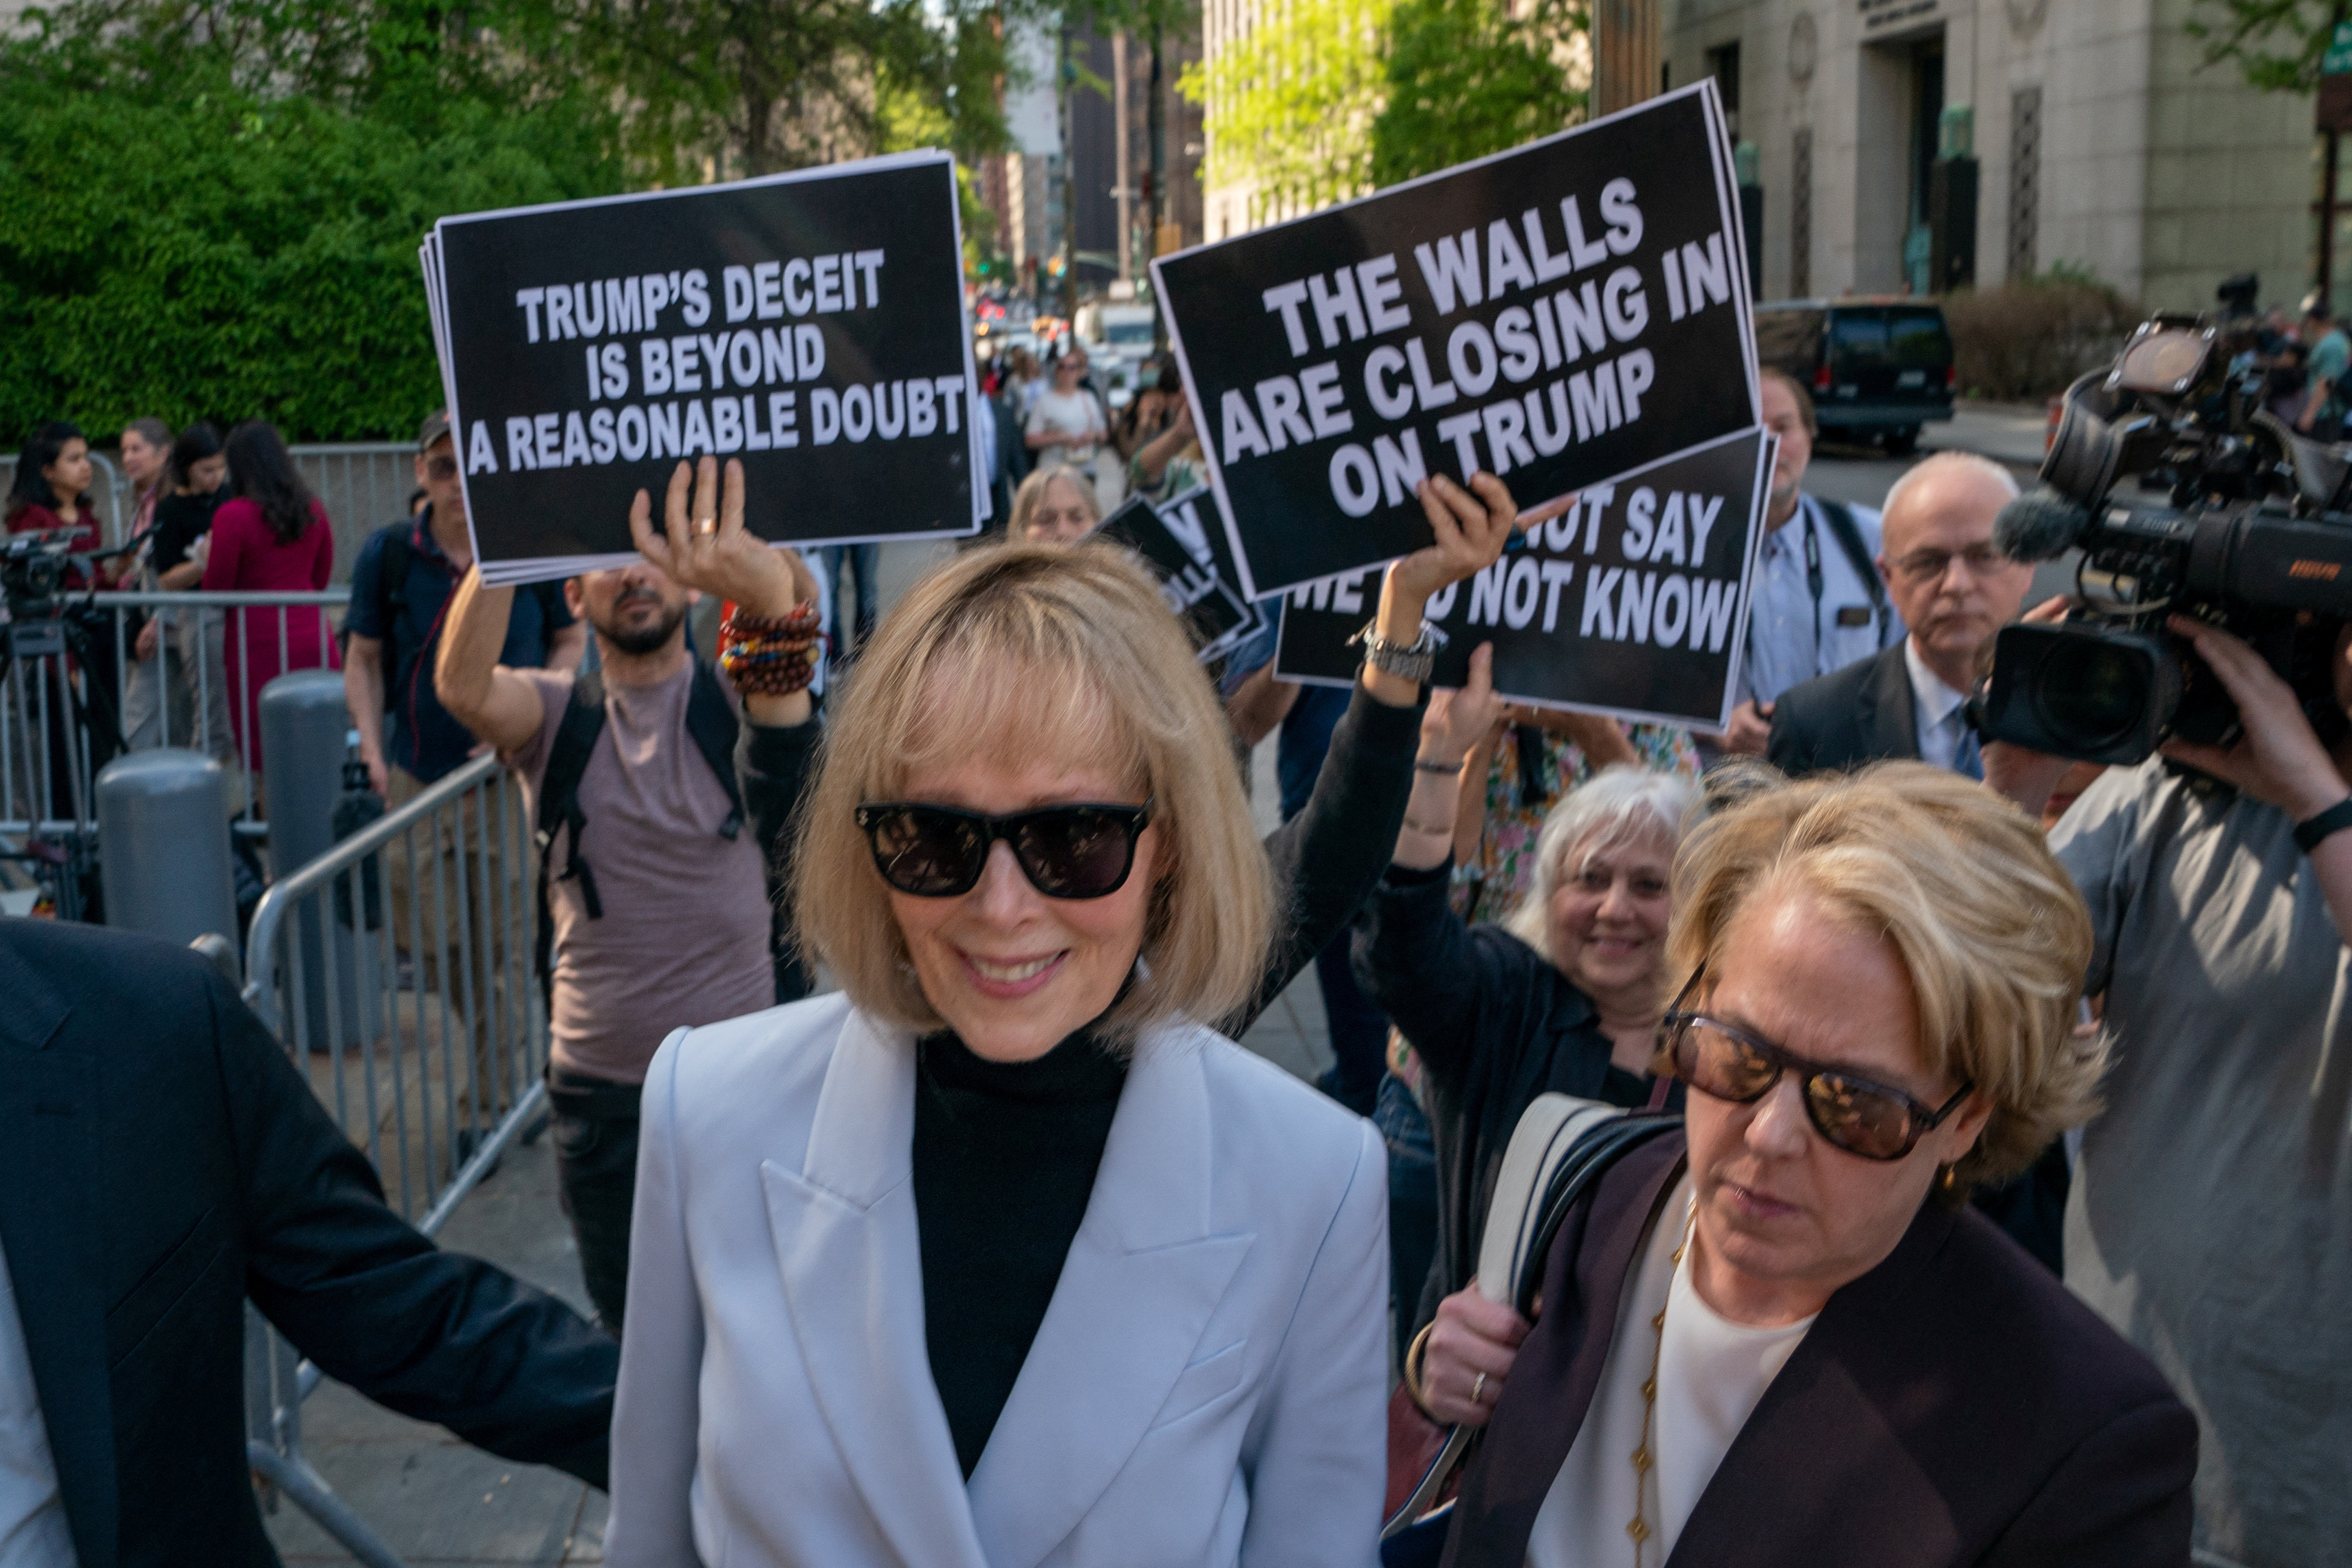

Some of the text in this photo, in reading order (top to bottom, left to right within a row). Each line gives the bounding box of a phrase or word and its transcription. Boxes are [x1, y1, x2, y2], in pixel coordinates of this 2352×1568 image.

[516, 249, 885, 343] TRUMP'S DECEIT
[1262, 177, 1643, 357] THE WALLS
[585, 324, 826, 401] IS BEYOND
[1221, 232, 1730, 465] ARE CLOSING IN
[468, 375, 966, 475] A REASONABLE DOUBT
[1329, 348, 1655, 517] ON TRUMP
[1525, 486, 1725, 569] OT SAY
[1467, 555, 1574, 633] NOT
[1579, 564, 1738, 654] KNOW
